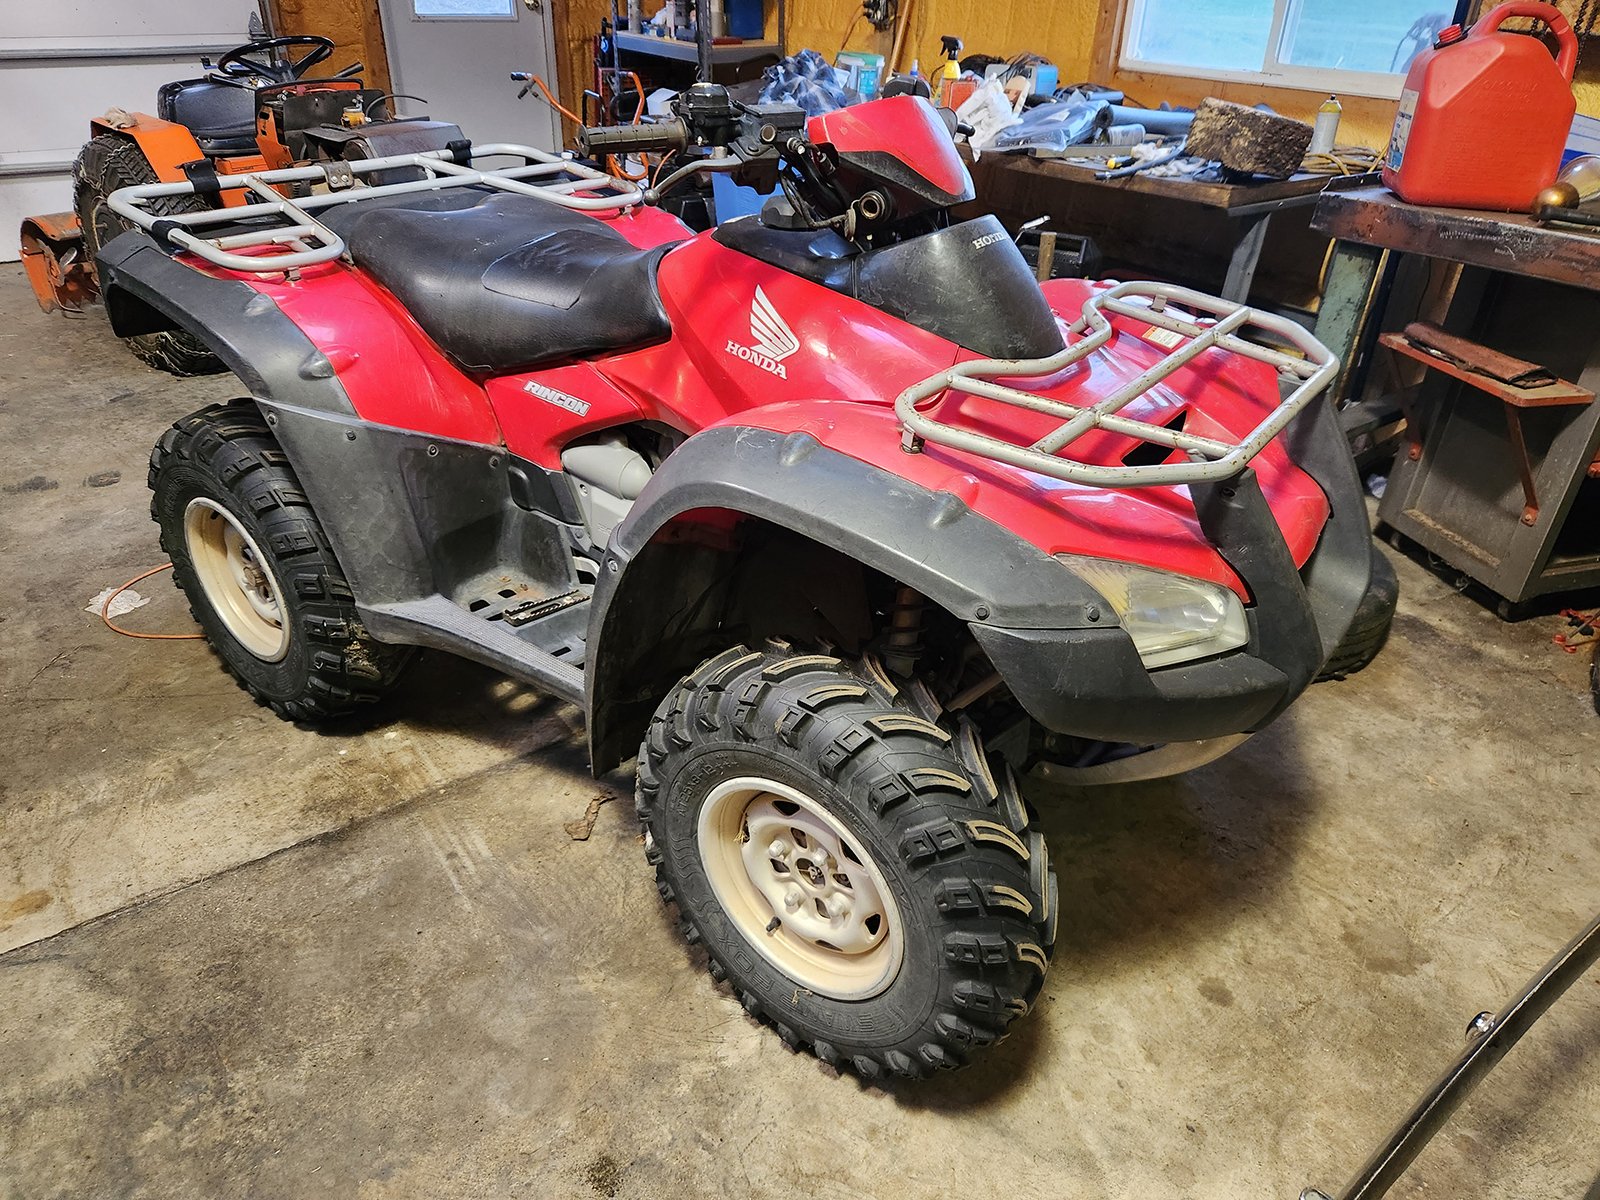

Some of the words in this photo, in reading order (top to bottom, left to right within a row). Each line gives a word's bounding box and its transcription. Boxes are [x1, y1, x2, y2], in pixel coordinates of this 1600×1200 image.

[971, 231, 1008, 250] HOND
[724, 339, 788, 380] HONDA
[523, 380, 590, 416] RINCON
